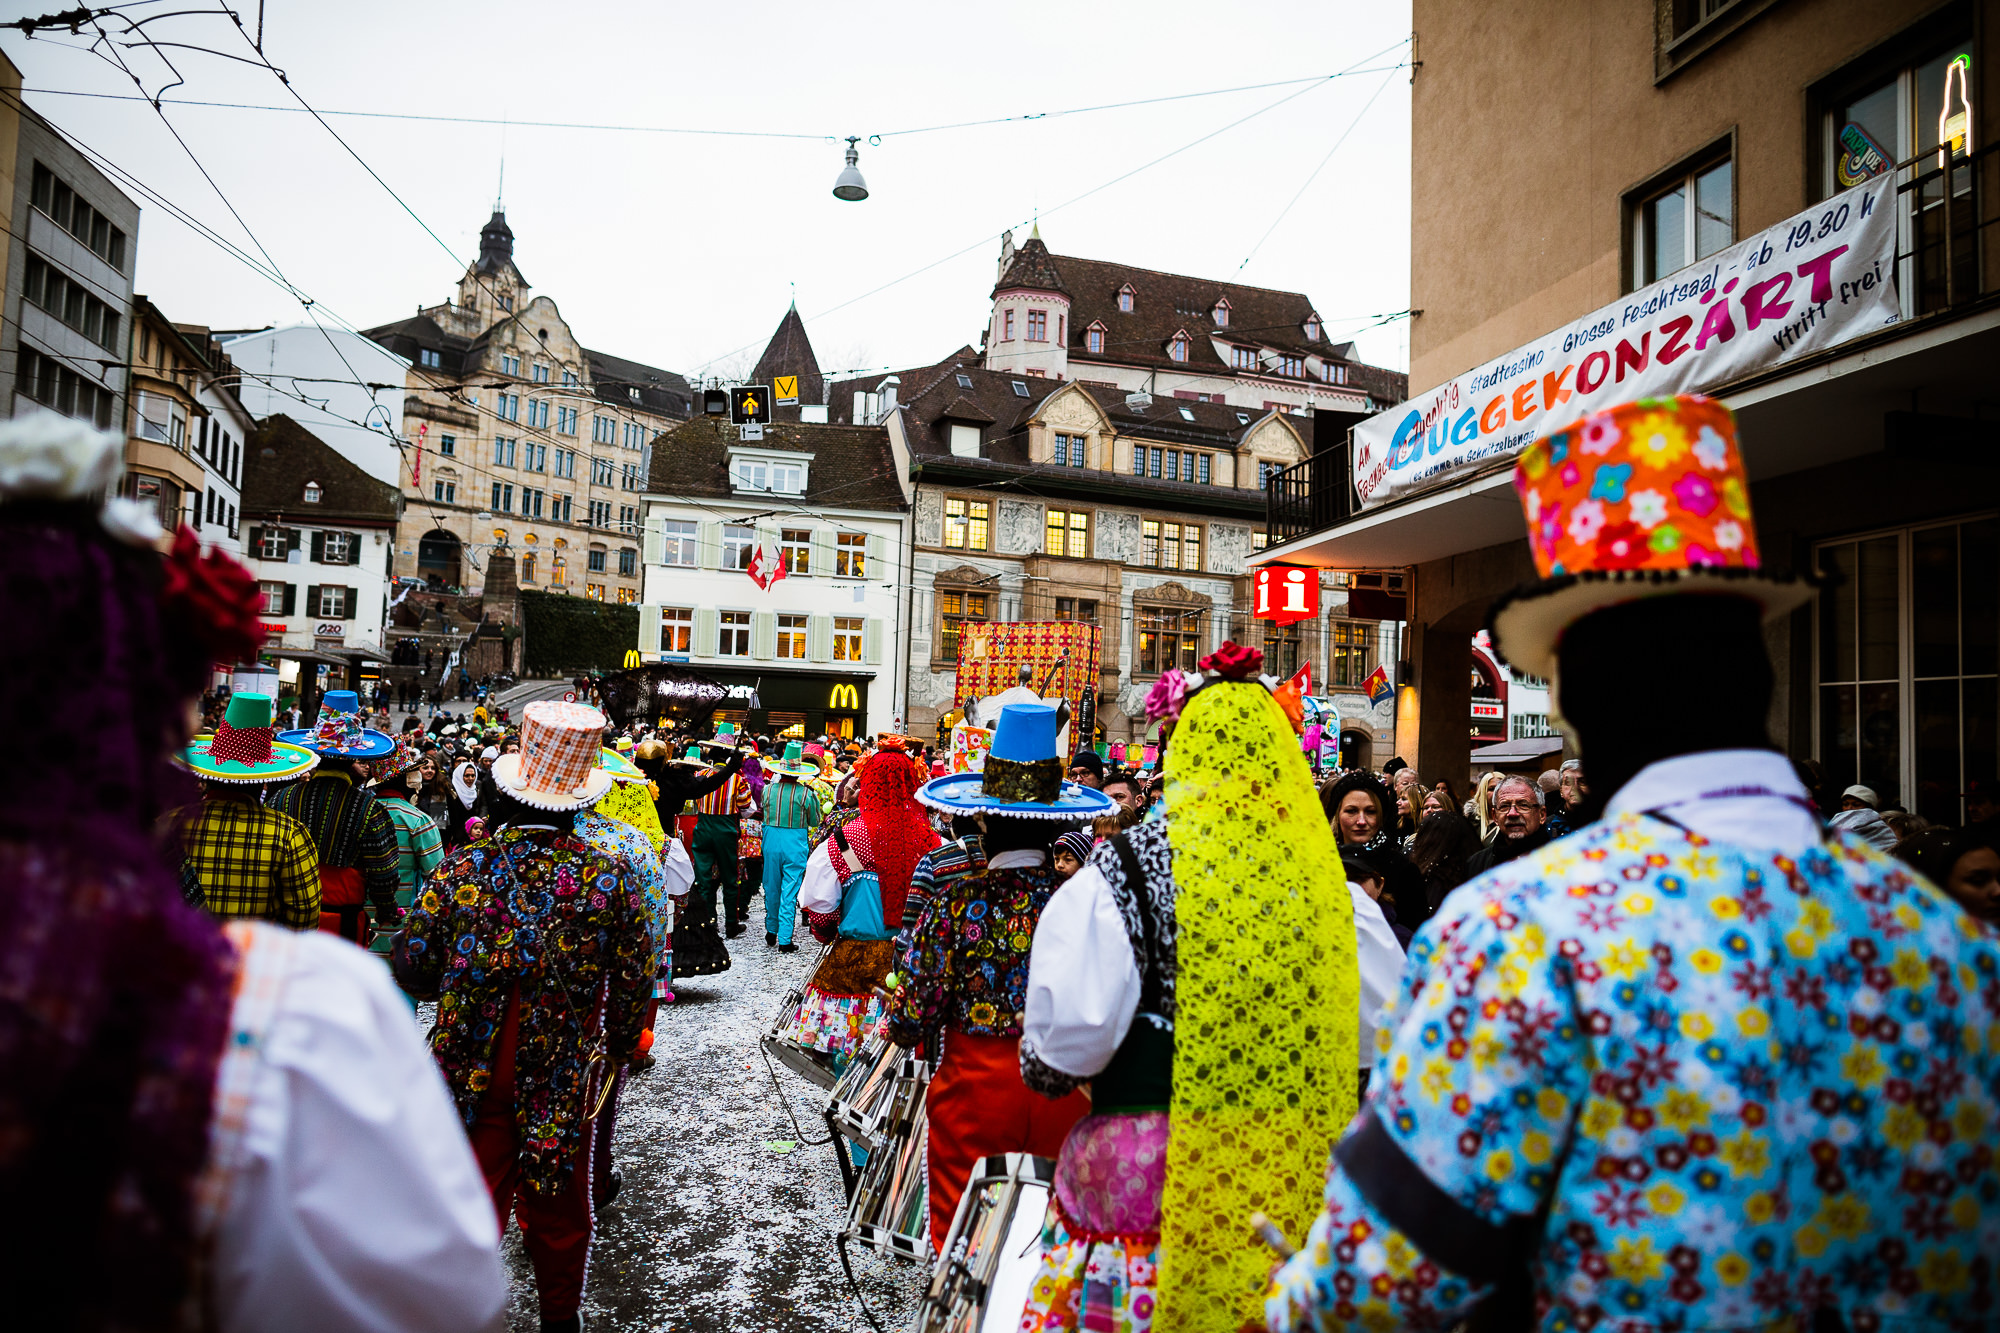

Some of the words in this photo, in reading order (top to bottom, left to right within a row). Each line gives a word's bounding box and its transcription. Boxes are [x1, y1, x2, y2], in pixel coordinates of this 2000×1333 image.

[1843, 126, 1868, 158] PAPA
[1470, 350, 1544, 394] Stadtcasino
[1563, 318, 1615, 353] Grosse
[1622, 264, 1719, 327] Feschtsaal
[1747, 240, 1773, 271] ab
[1785, 203, 1849, 252] 19.30
[1860, 192, 1875, 219] h
[1839, 261, 1882, 304] frei
[1386, 244, 1849, 471] GUGGEKONZÄRT
[1358, 442, 1371, 471] Am
[1424, 460, 1452, 477] kemme
[1454, 456, 1463, 466] au
[1282, 569, 1310, 612] i
